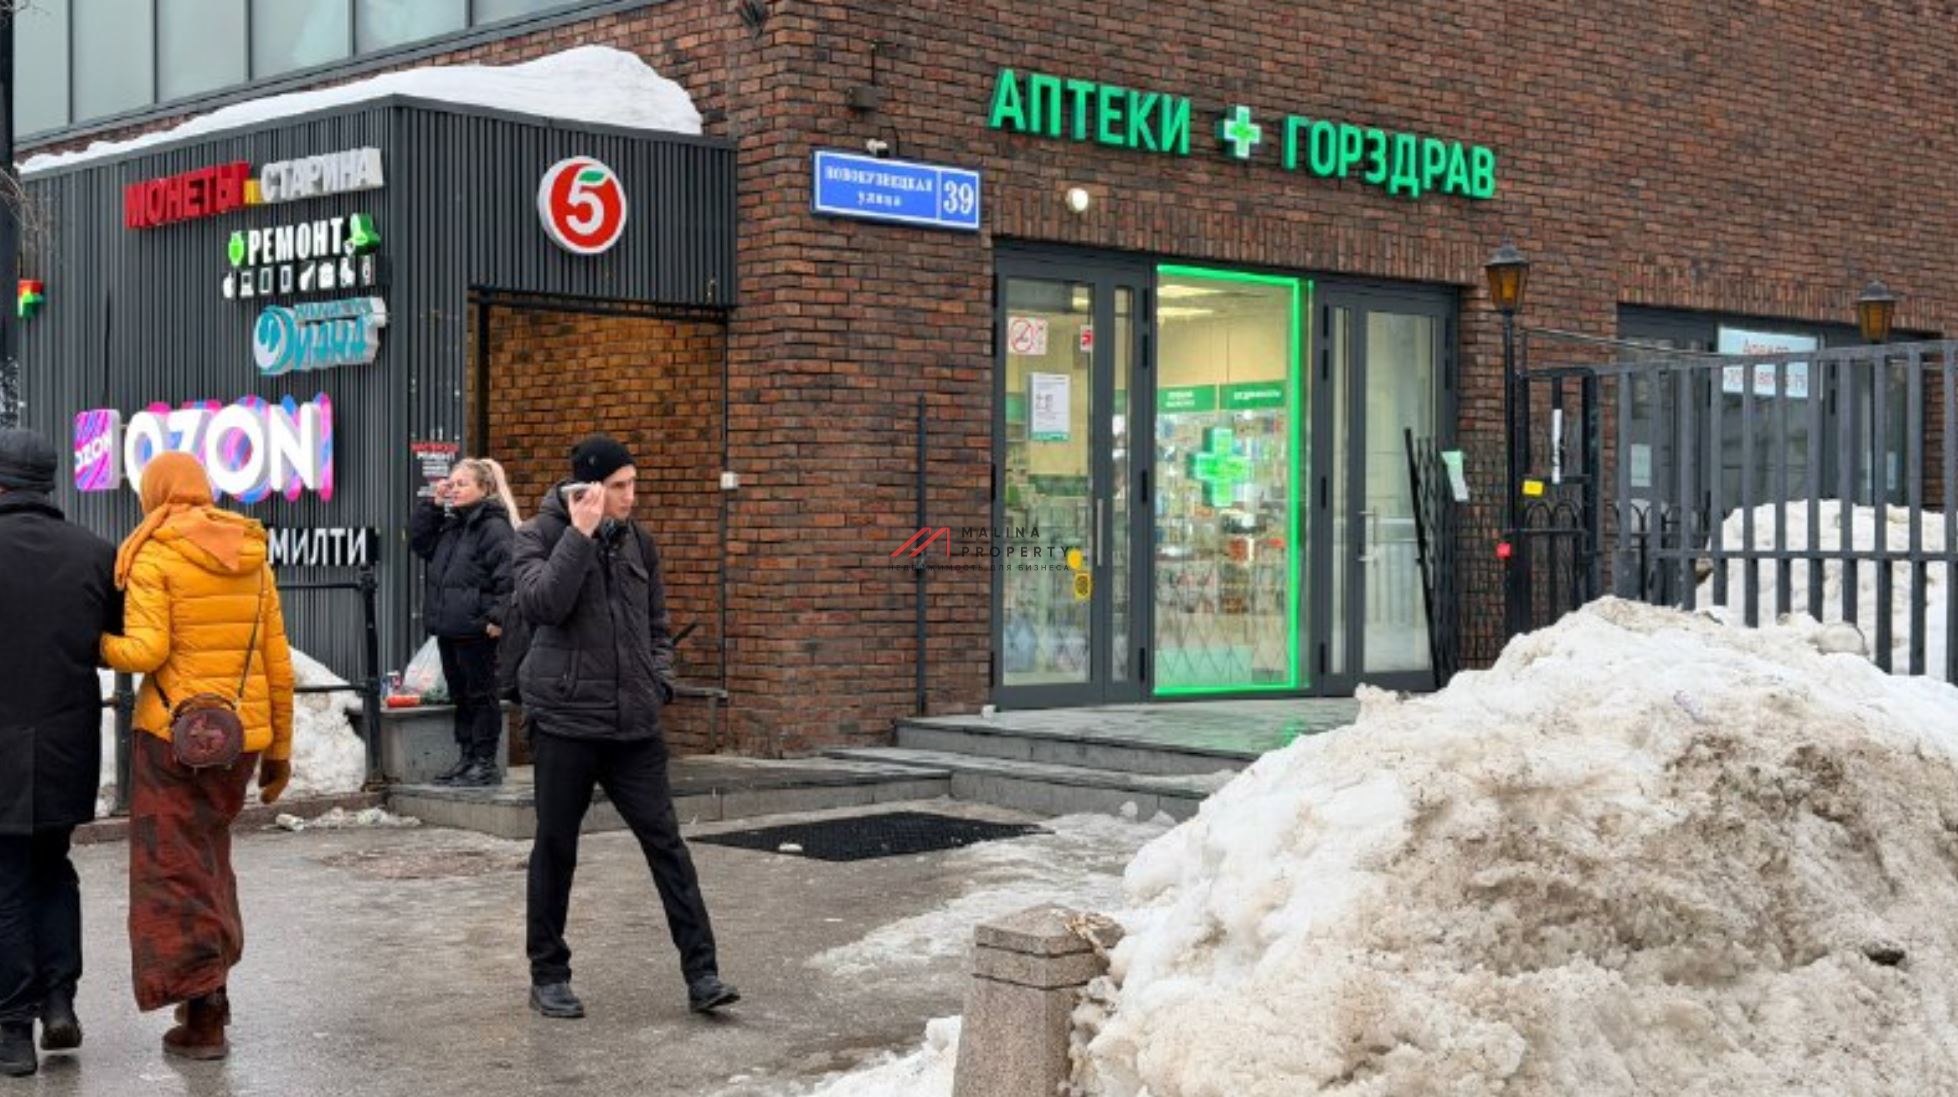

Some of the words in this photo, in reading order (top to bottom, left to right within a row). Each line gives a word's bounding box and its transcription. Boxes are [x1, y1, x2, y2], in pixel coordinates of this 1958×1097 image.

[988, 68, 1192, 155] АПТЕКИ
[1281, 114, 1497, 199] ГОРЗДРАВ
[125, 161, 250, 228] МОНЕТЫ
[261, 147, 380, 203] СТАРИНА
[943, 180, 974, 215] 39
[248, 217, 344, 266] РЕМОНТ
